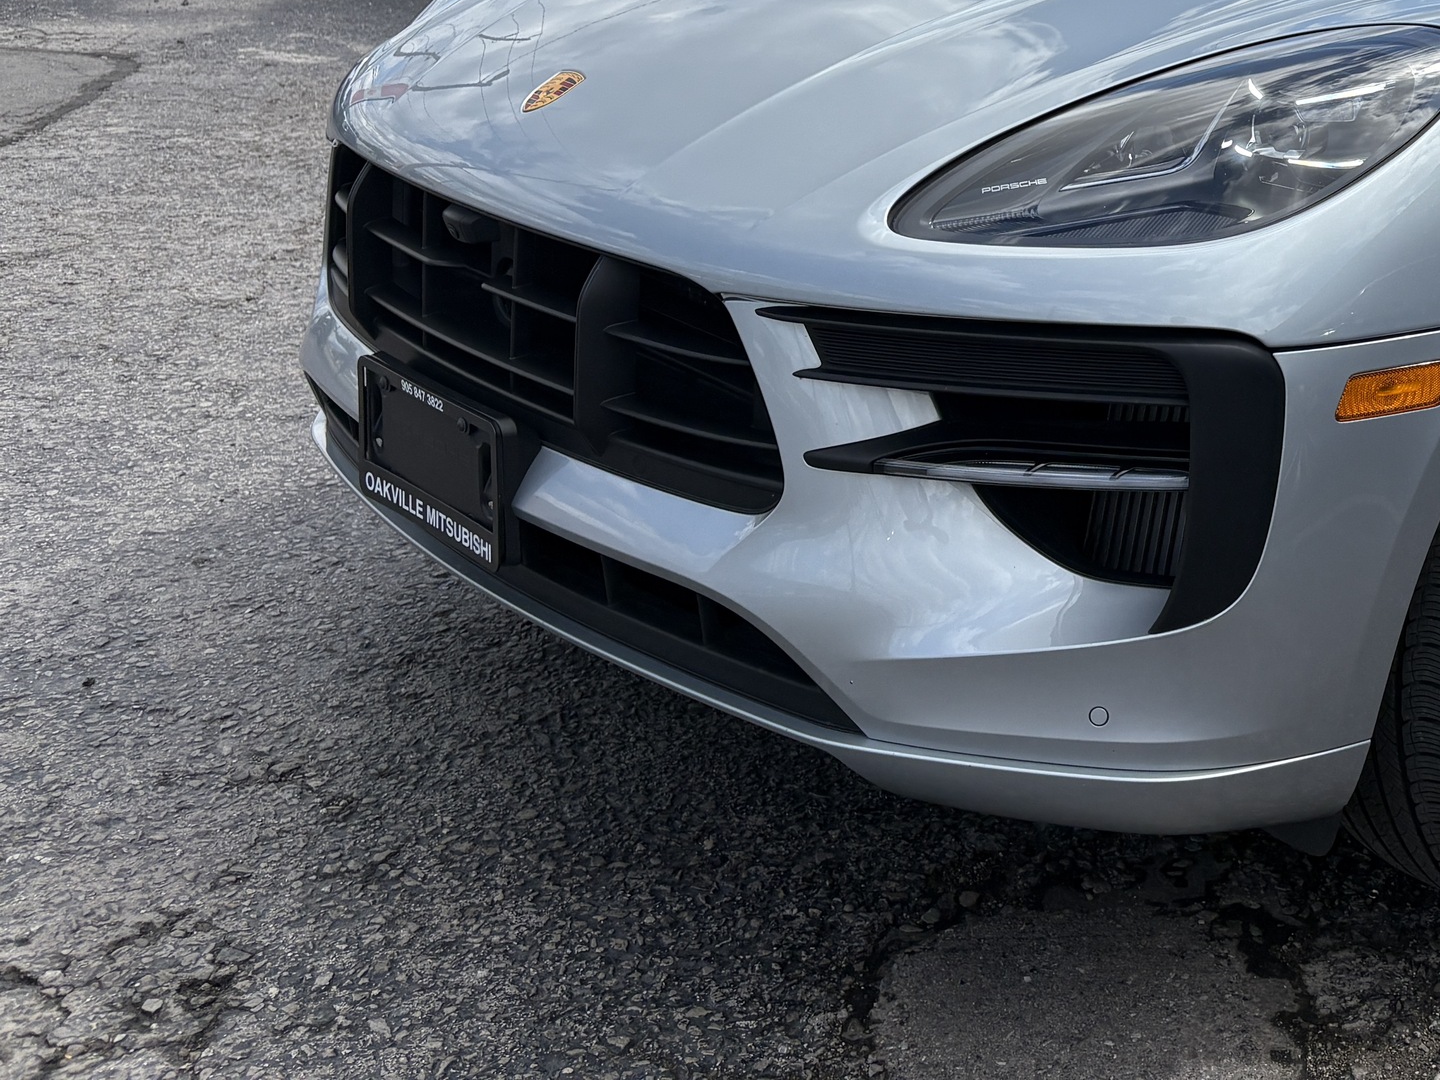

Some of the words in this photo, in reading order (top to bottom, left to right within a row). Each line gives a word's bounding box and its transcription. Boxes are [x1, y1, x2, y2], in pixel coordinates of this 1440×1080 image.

[981, 177, 1047, 194] PORSCHE
[400, 379, 413, 395] 905
[413, 386, 426, 402] 847
[427, 393, 444, 412] 3822
[365, 471, 424, 520] OAKVILLE
[426, 504, 492, 563] MITSUBISHI
